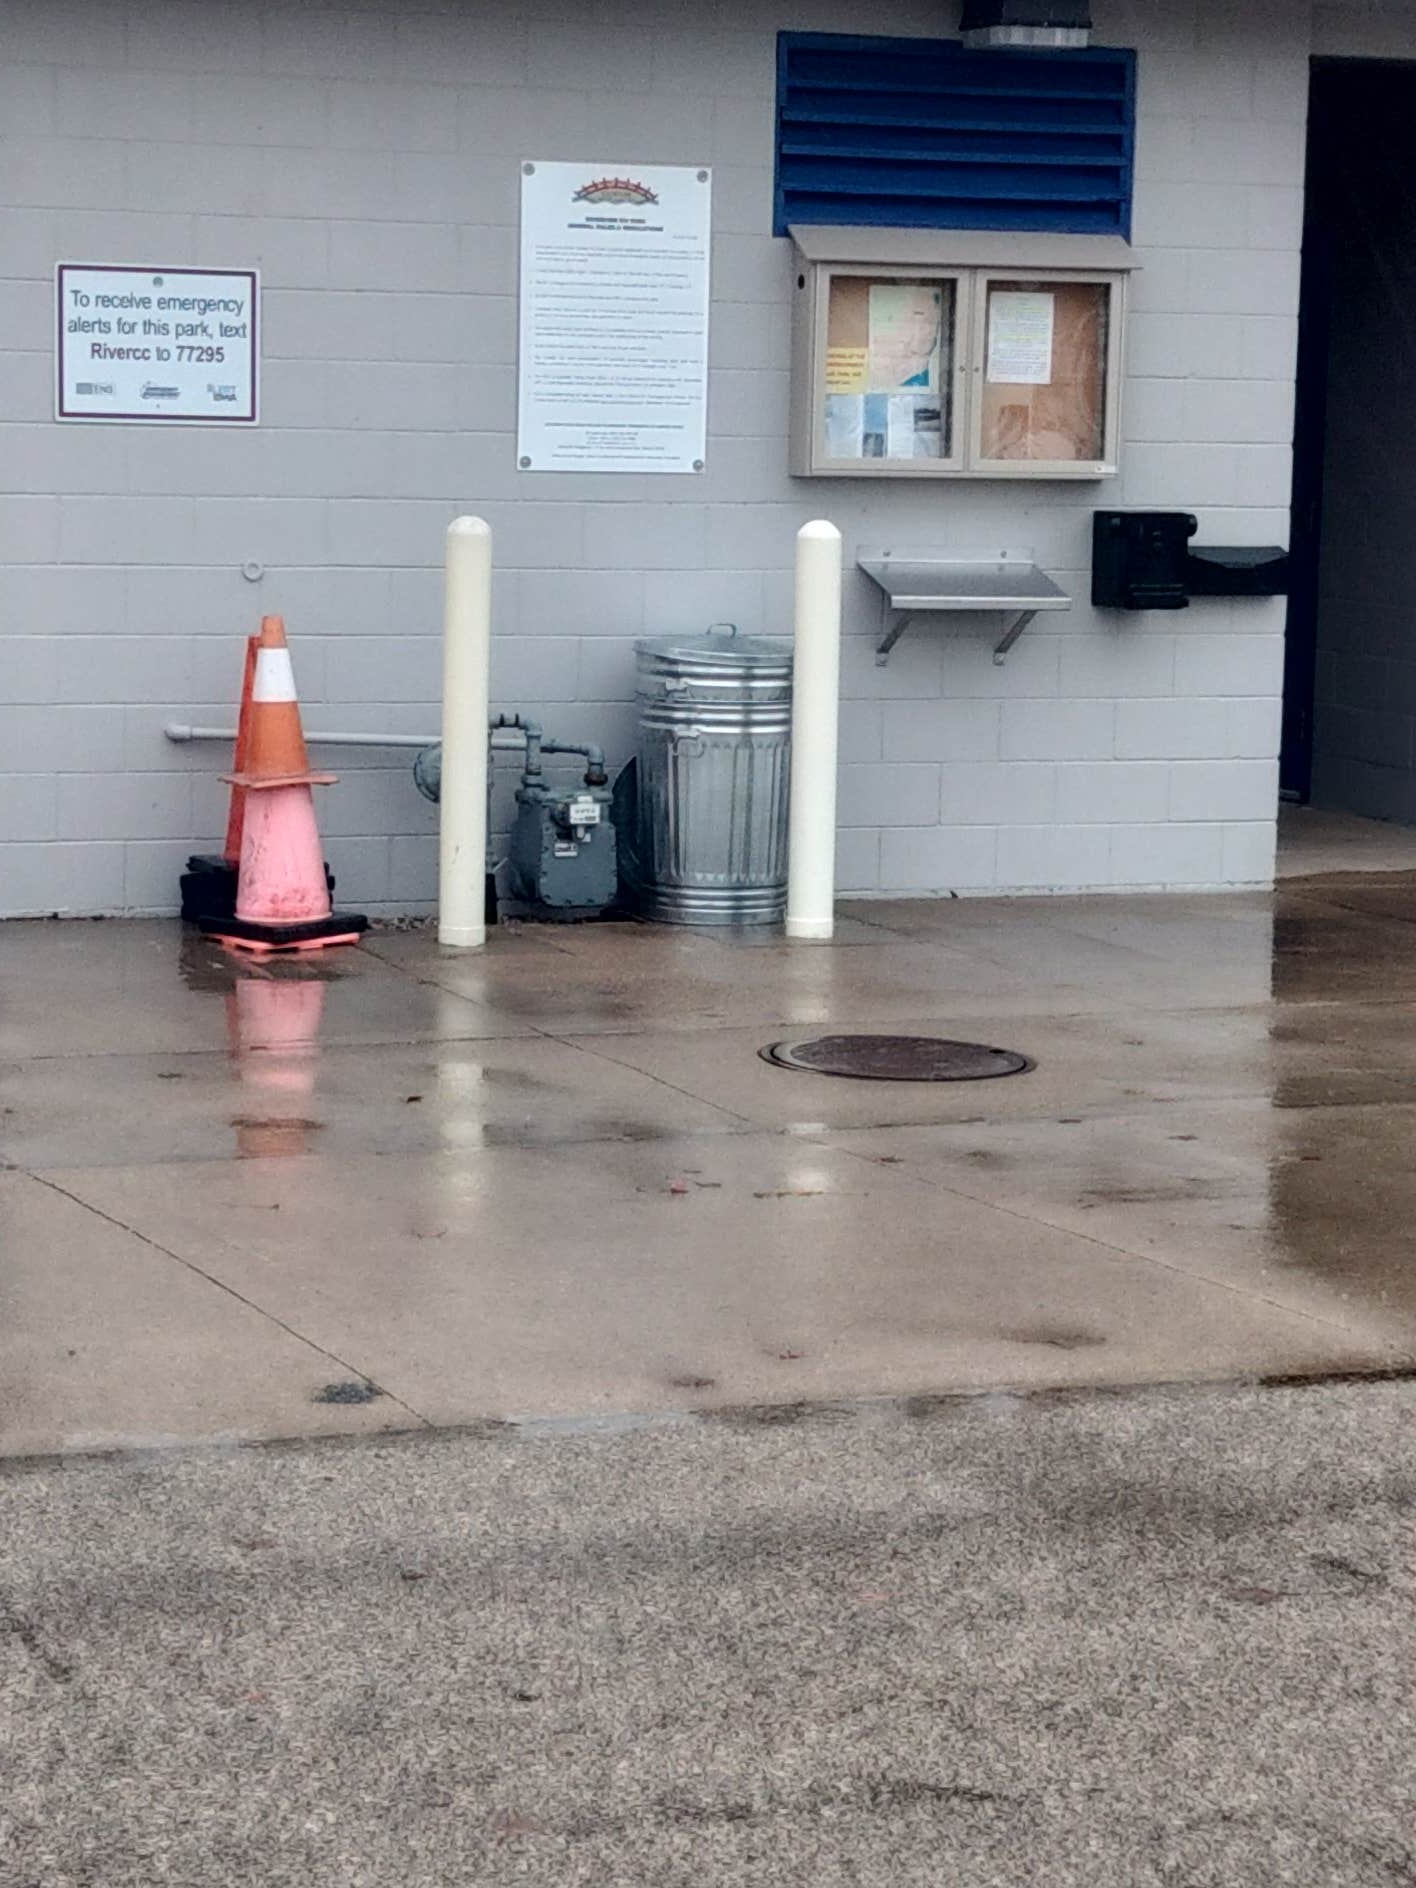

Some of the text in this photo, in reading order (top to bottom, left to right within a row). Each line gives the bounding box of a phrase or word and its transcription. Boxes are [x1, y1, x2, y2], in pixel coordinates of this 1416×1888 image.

[70, 289, 245, 317] To receive emergency
[68, 316, 247, 340] alerts for this park, text
[90, 342, 225, 363] Rivercc to 77295
